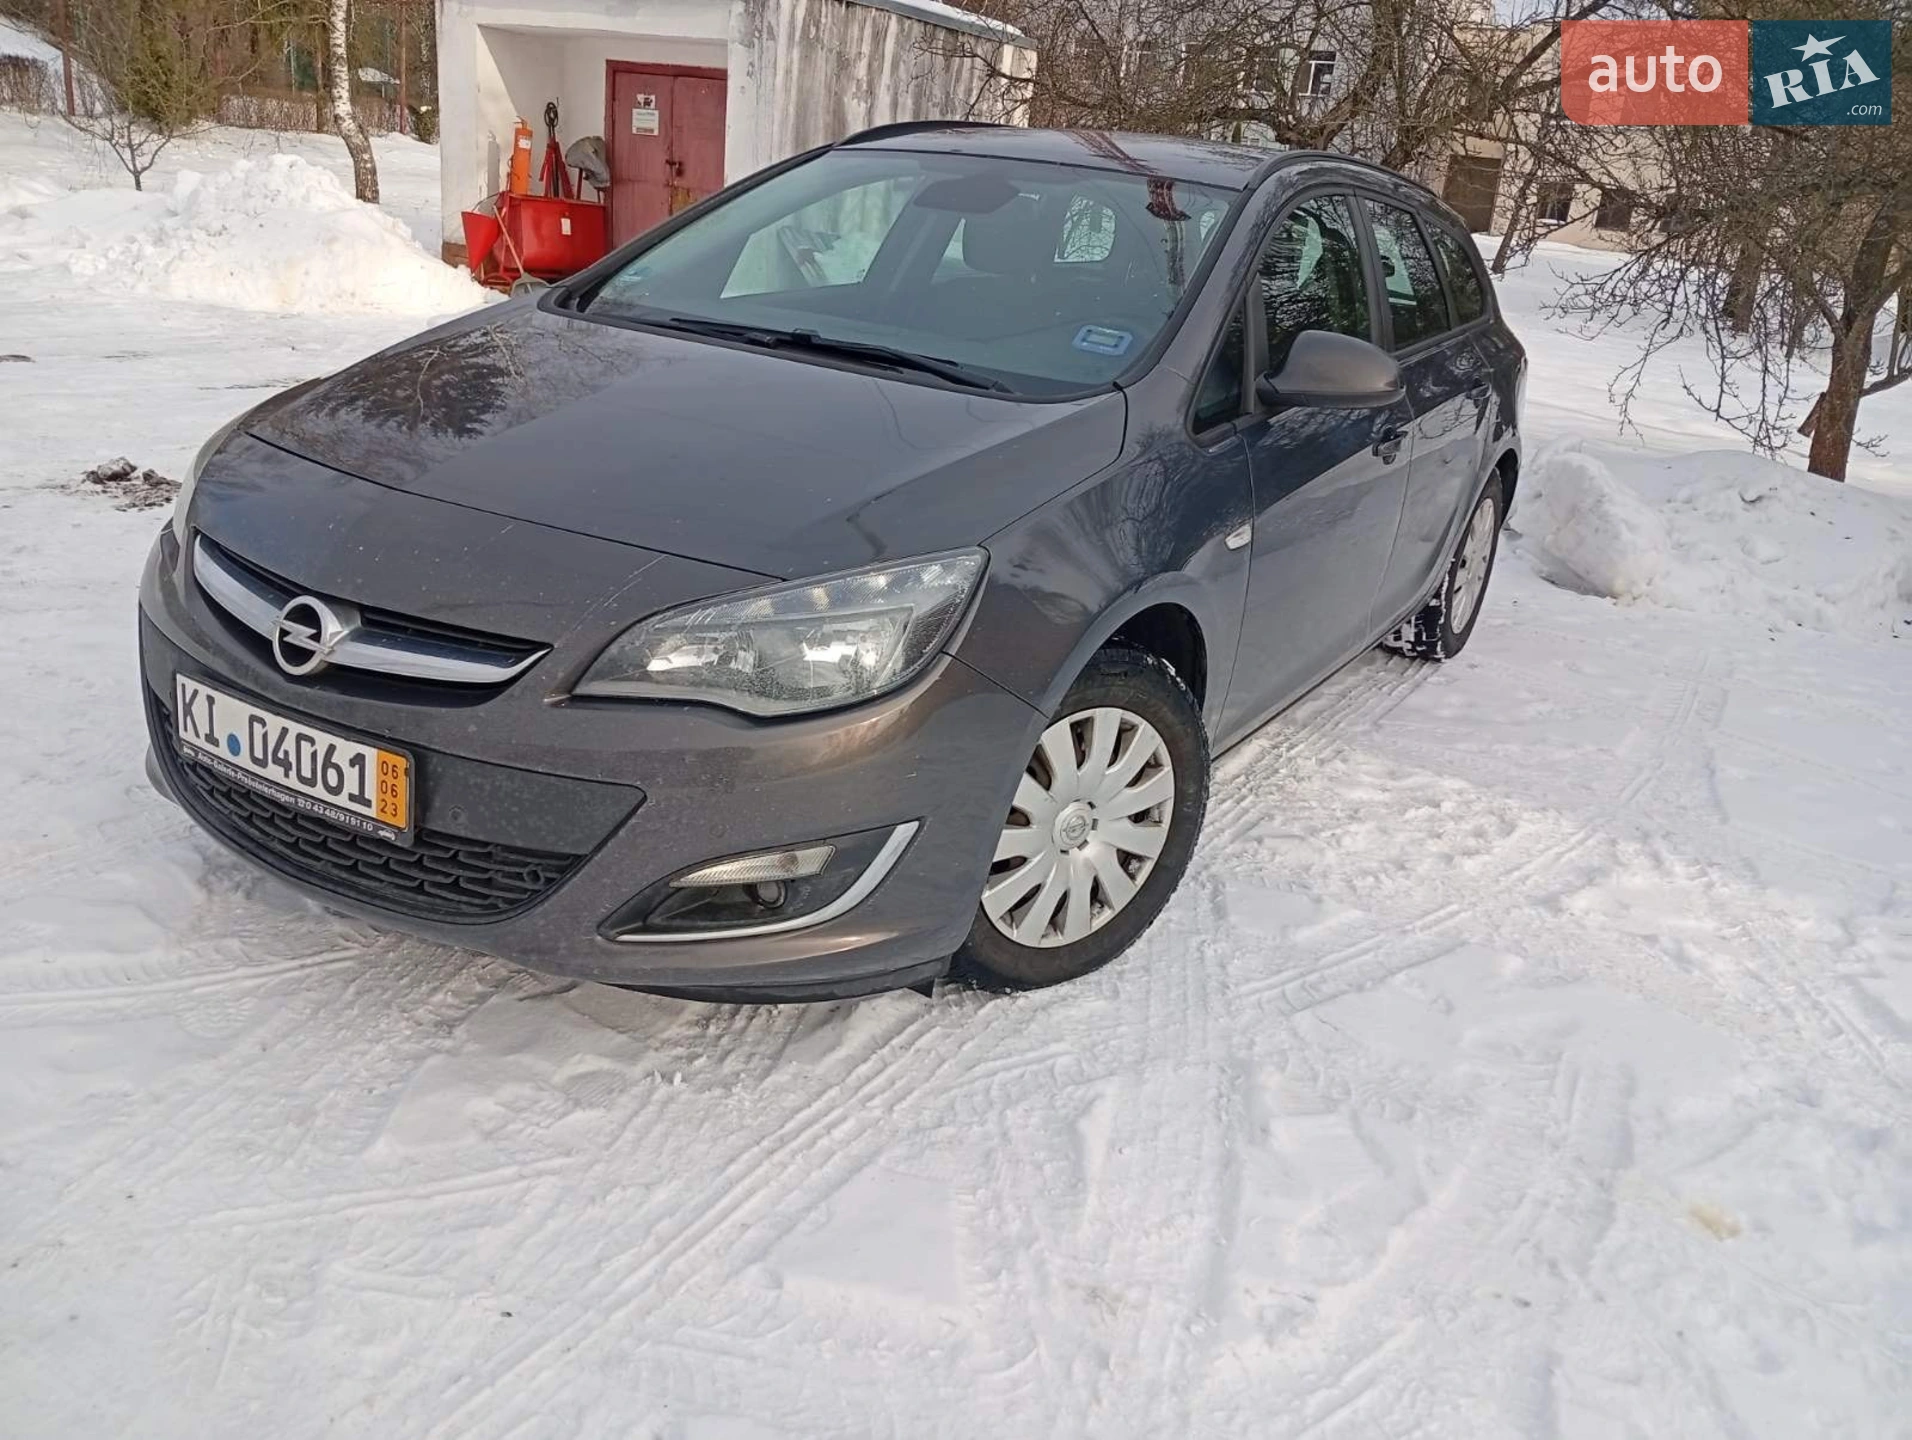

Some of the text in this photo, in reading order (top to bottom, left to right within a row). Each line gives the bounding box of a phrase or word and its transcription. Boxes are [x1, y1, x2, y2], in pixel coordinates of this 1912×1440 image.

[181, 683, 373, 809] KI 04061
[381, 760, 399, 779] 06
[380, 780, 398, 798] 06
[380, 799, 398, 817] 23
